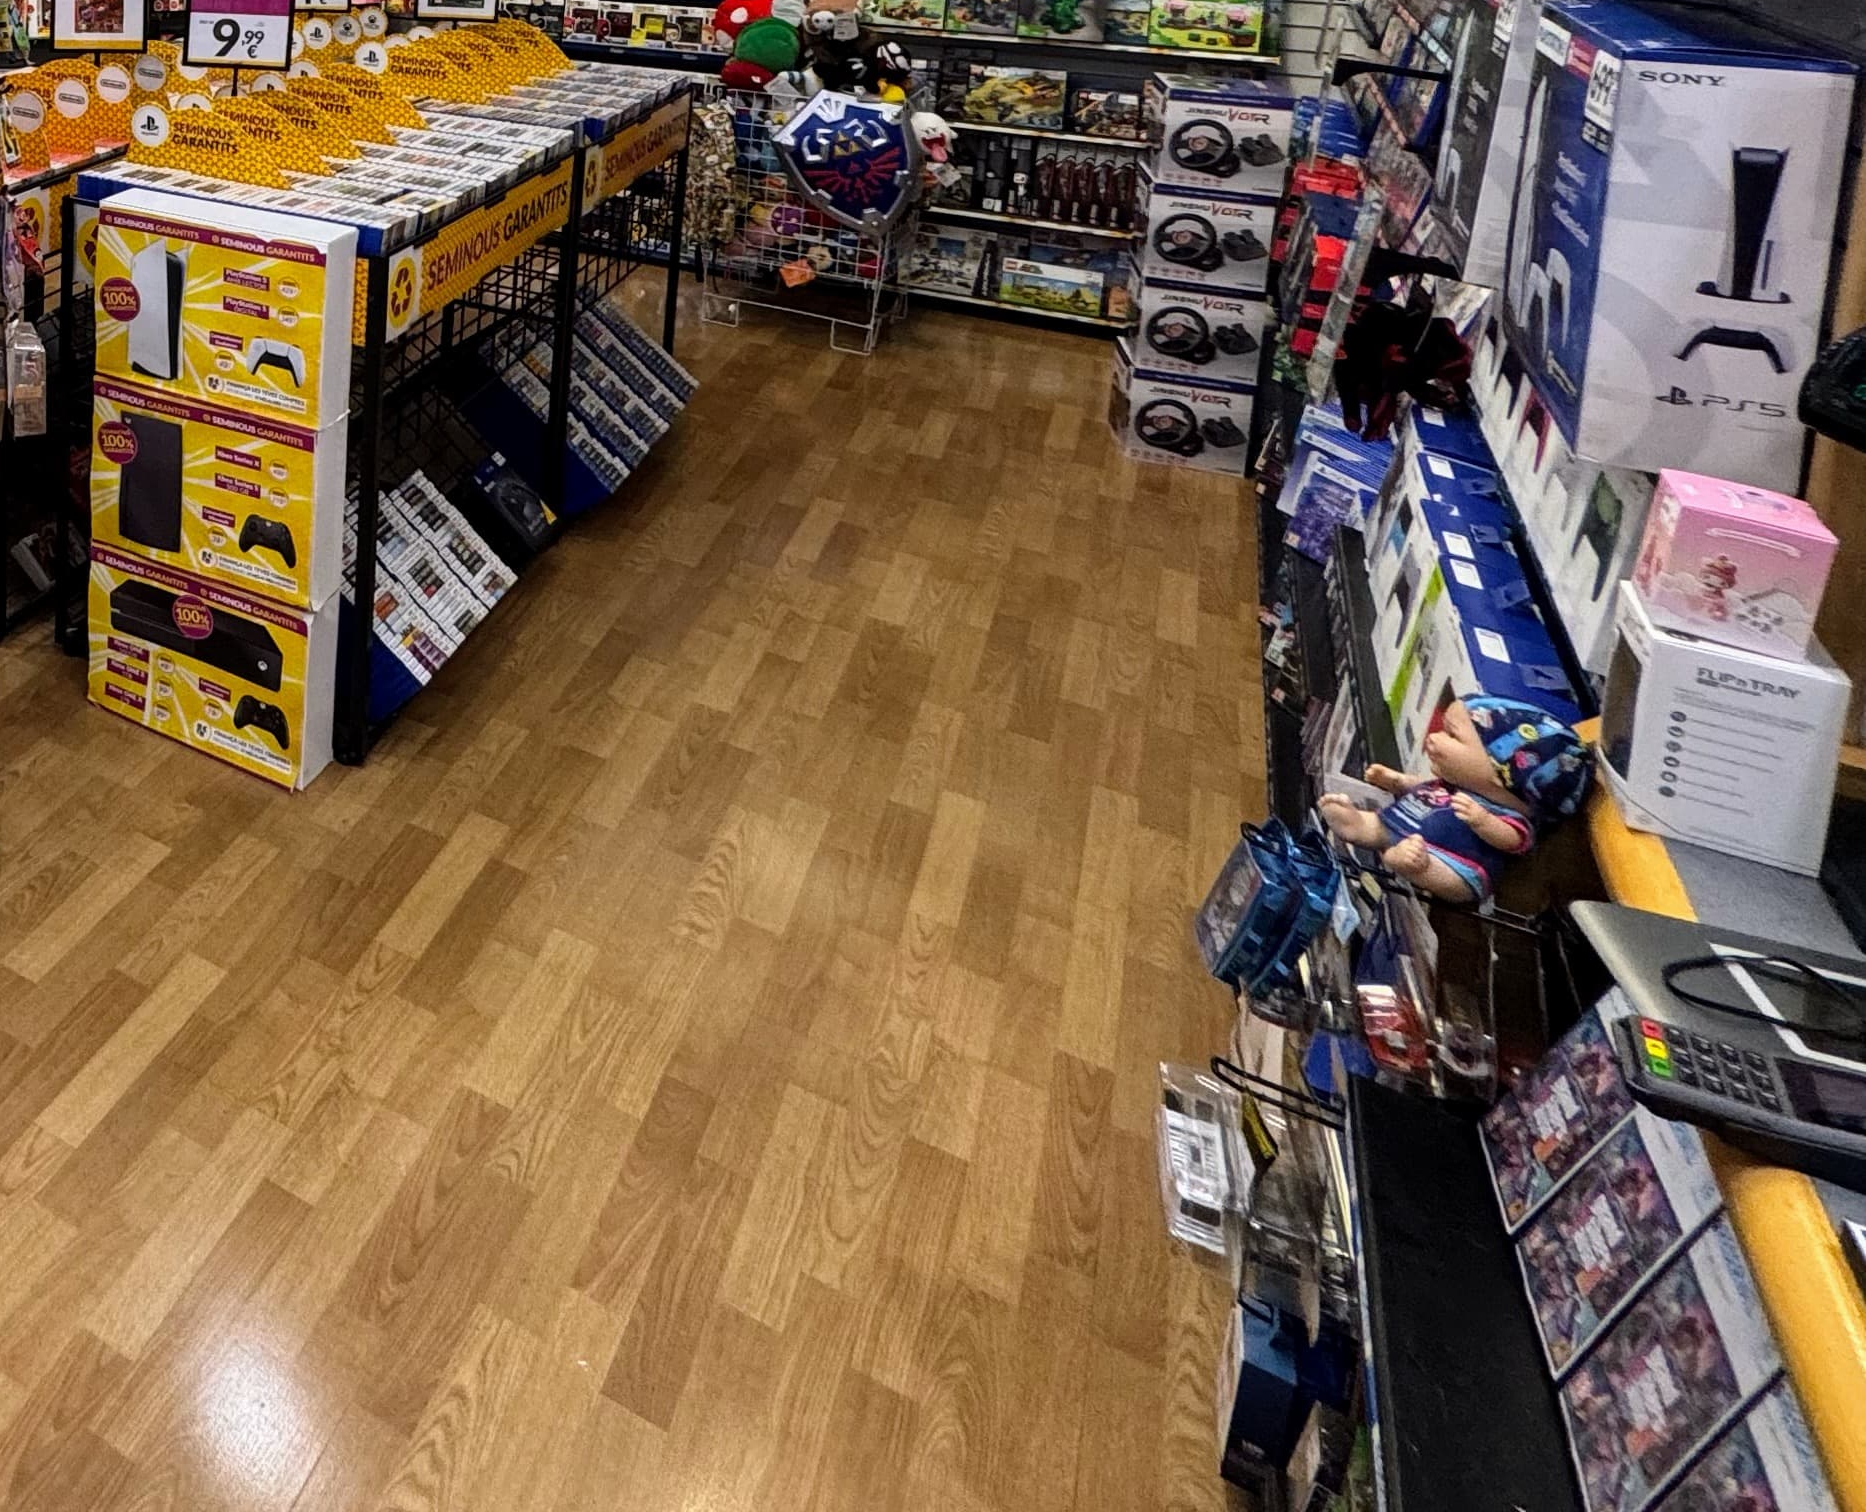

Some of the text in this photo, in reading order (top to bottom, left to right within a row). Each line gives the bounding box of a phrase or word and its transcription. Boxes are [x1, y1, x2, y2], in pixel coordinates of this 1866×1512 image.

[247, 45, 258, 58] €
[390, 54, 445, 71] SEMINOUS
[390, 65, 448, 80] GARANTITS
[1639, 69, 1726, 88] SONY
[173, 122, 233, 140] SEMINOUS
[172, 136, 238, 155] GARANTITS
[114, 216, 315, 262] SEMINOUS GARANTITS SEMINOUS GARANTITS
[427, 180, 567, 291] SEMINOUS GARANTITS
[103, 291, 136, 307] 100%
[1702, 395, 1787, 419] PS5
[107, 389, 304, 448] SEMINOUS GARANTITS SEMINOUS GARANTITS
[101, 435, 134, 450] 100%
[105, 555, 298, 630] SEMINOUS GARANTITS SEMINOUS GARANTITS
[175, 607, 209, 624] 100%
[1697, 667, 1735, 683] FLIP
[1748, 679, 1801, 698] TRAY
